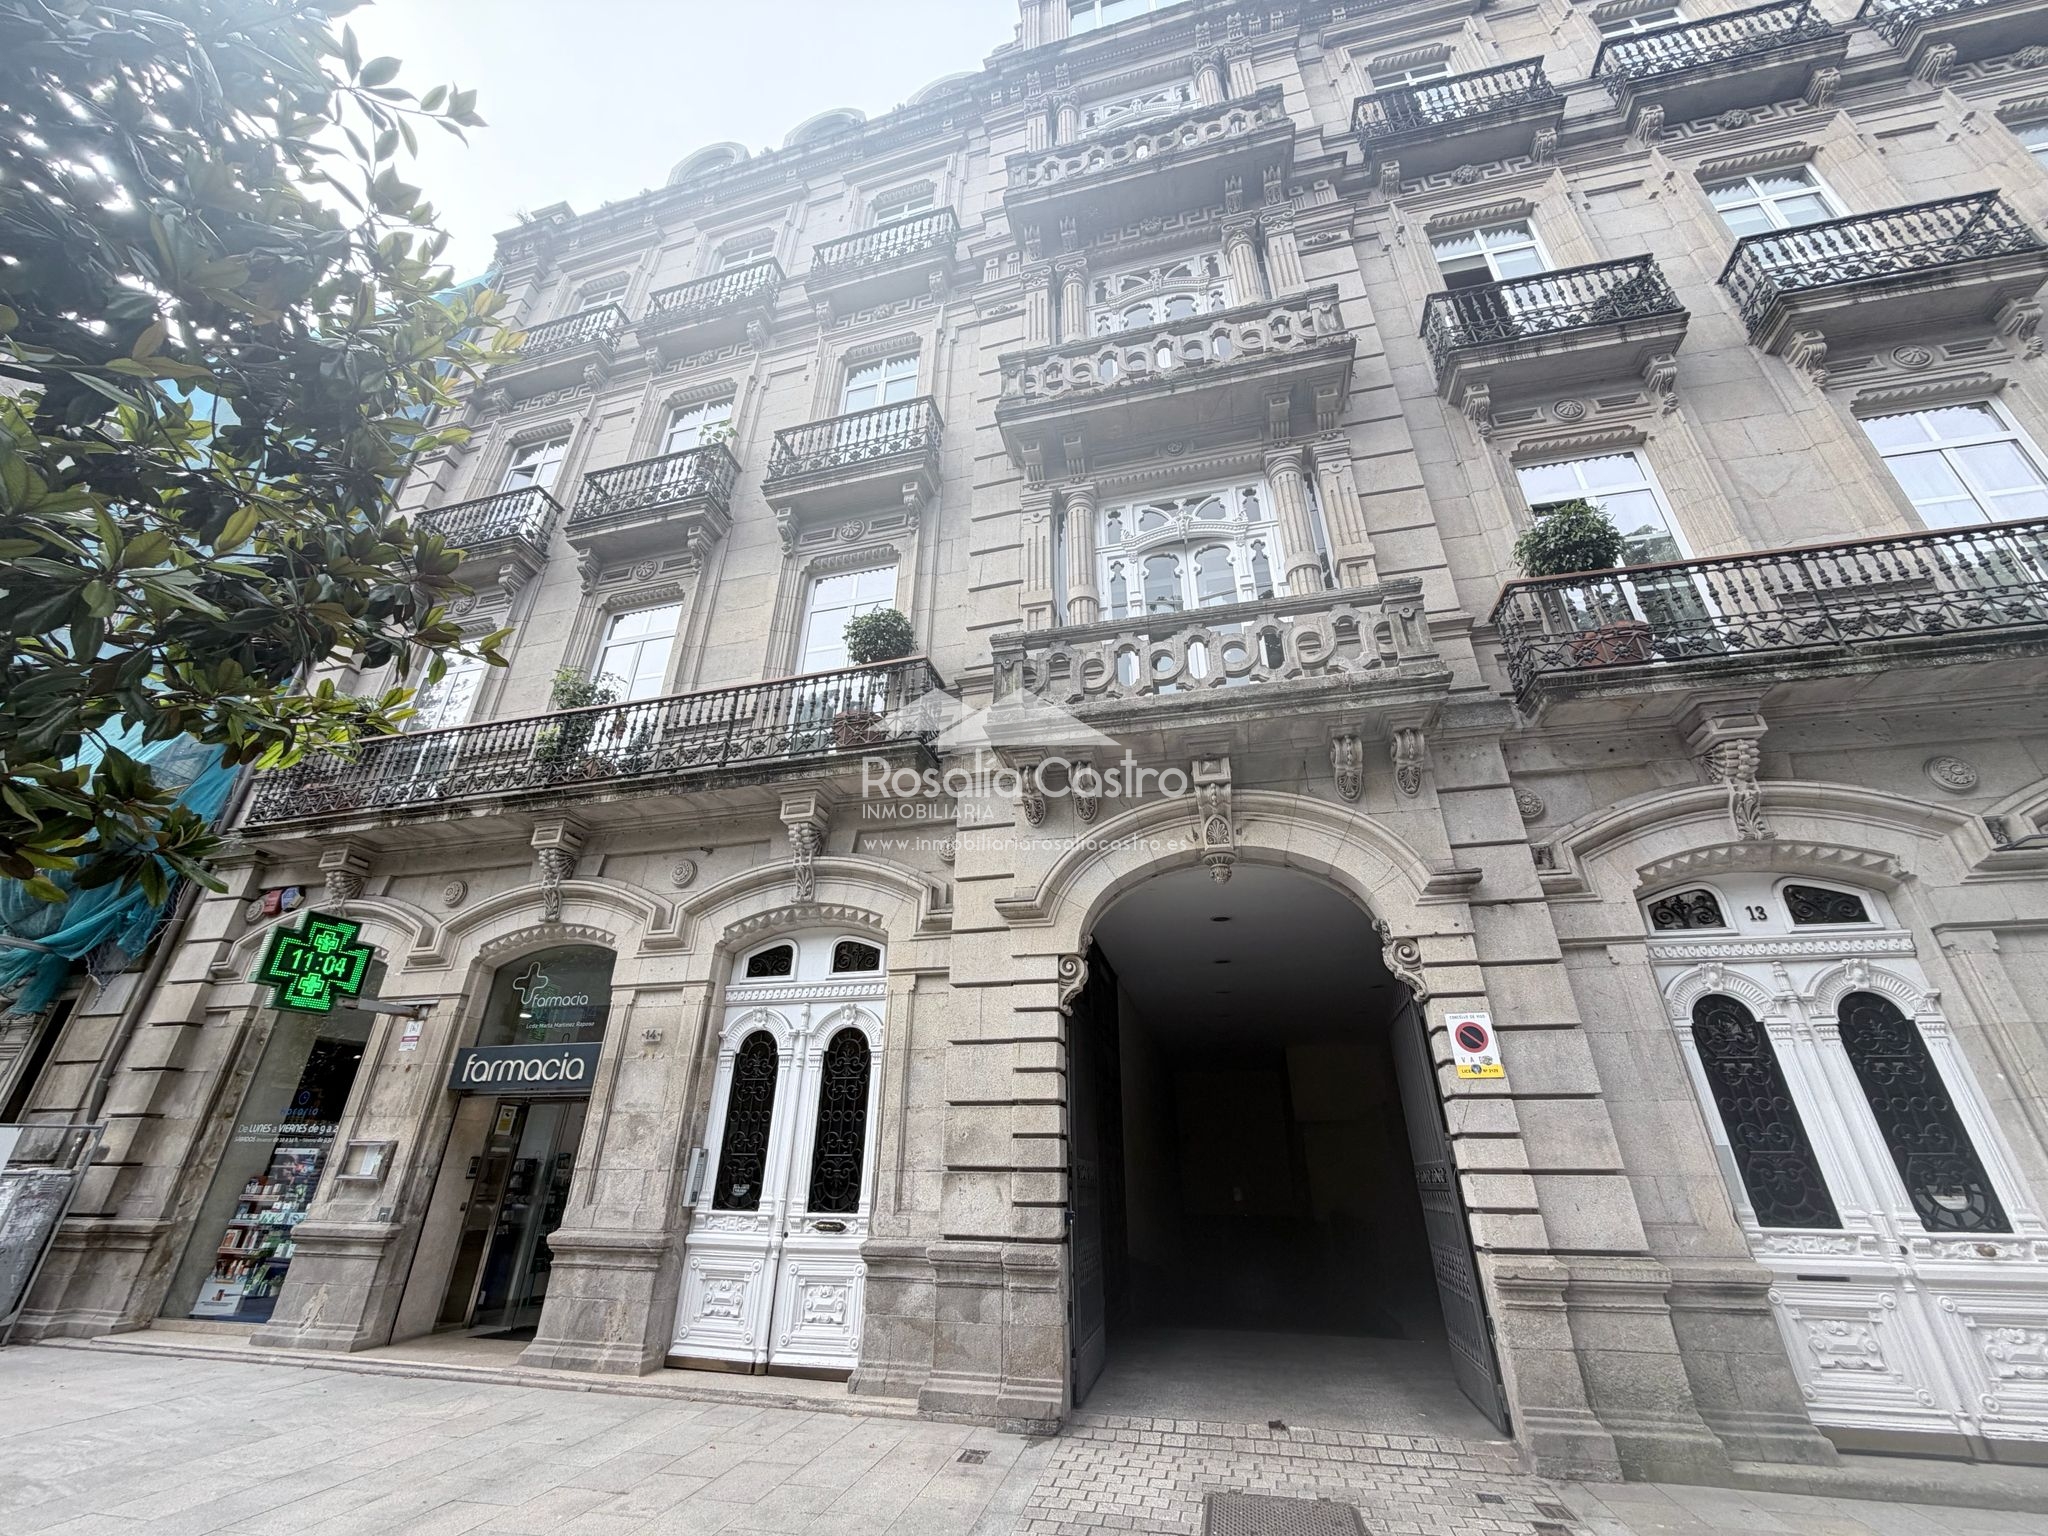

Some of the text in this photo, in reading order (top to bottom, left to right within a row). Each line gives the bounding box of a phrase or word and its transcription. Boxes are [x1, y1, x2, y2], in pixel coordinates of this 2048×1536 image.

[1744, 905, 1768, 921] 13
[292, 949, 348, 978] 11:04
[531, 991, 589, 1008] farmacia
[461, 1051, 585, 1083] farmacia
[248, 1123, 273, 1133] LUNES
[278, 1123, 308, 1133] VIERNES
[307, 1123, 320, 1133] de
